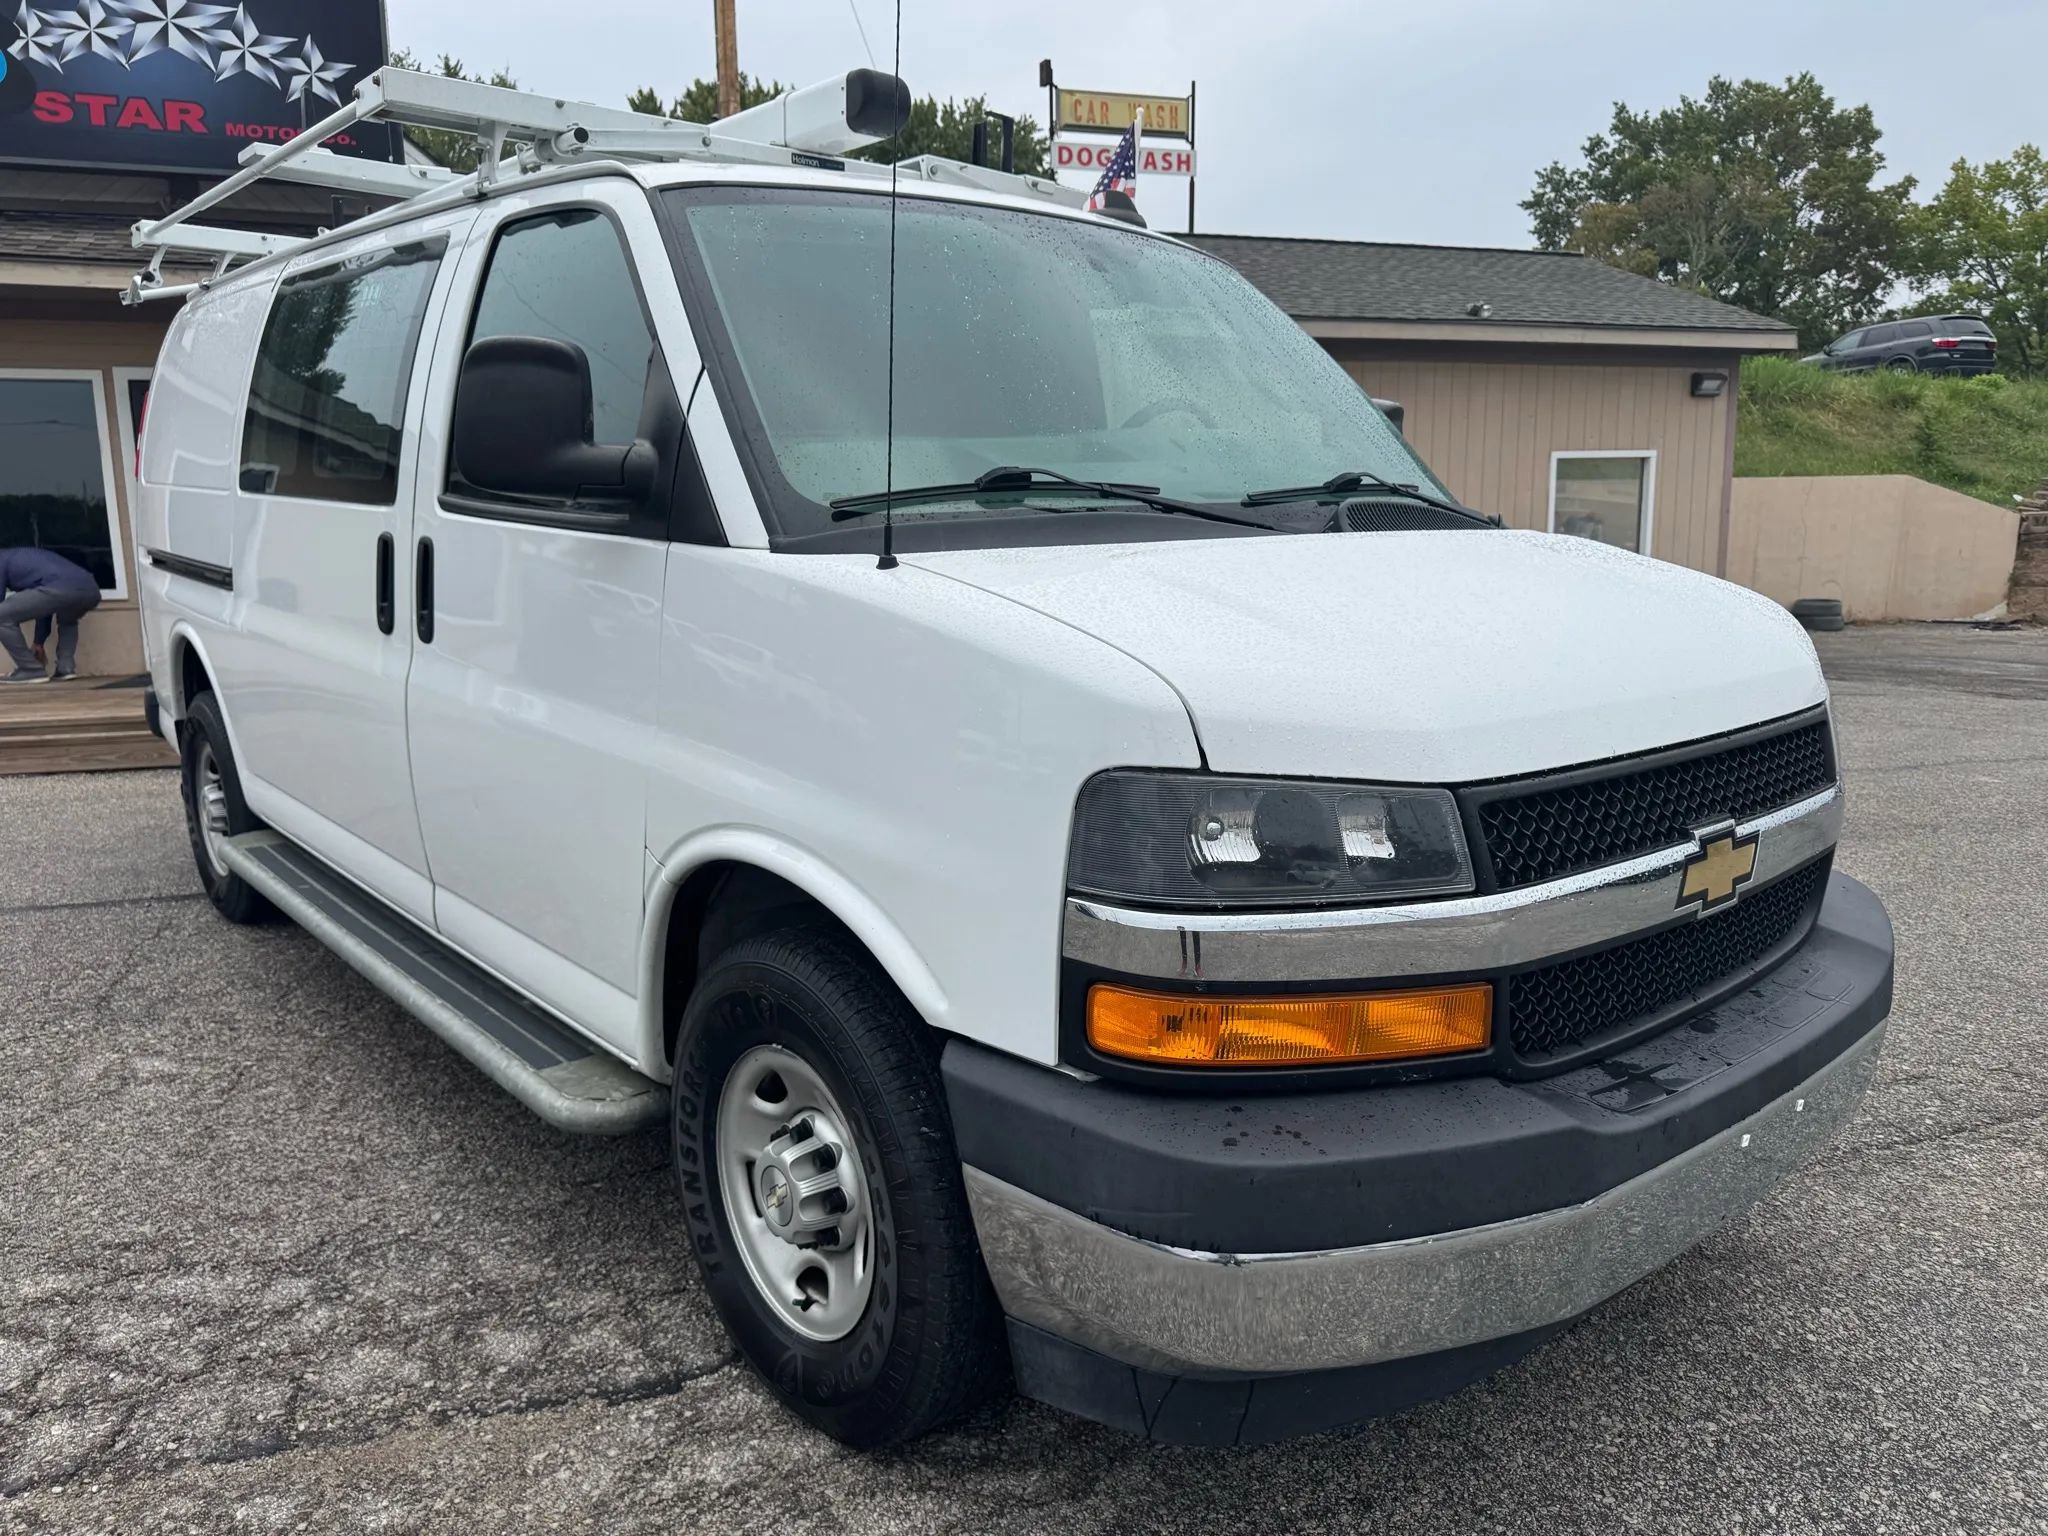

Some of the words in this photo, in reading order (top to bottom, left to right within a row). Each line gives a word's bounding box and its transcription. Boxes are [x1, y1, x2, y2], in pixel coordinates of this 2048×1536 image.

[32, 90, 208, 134] STAR
[224, 122, 305, 141] MOTO
[1073, 98, 1110, 125] CAR
[1057, 145, 1112, 168] DOG
[1143, 151, 1191, 173] ASH
